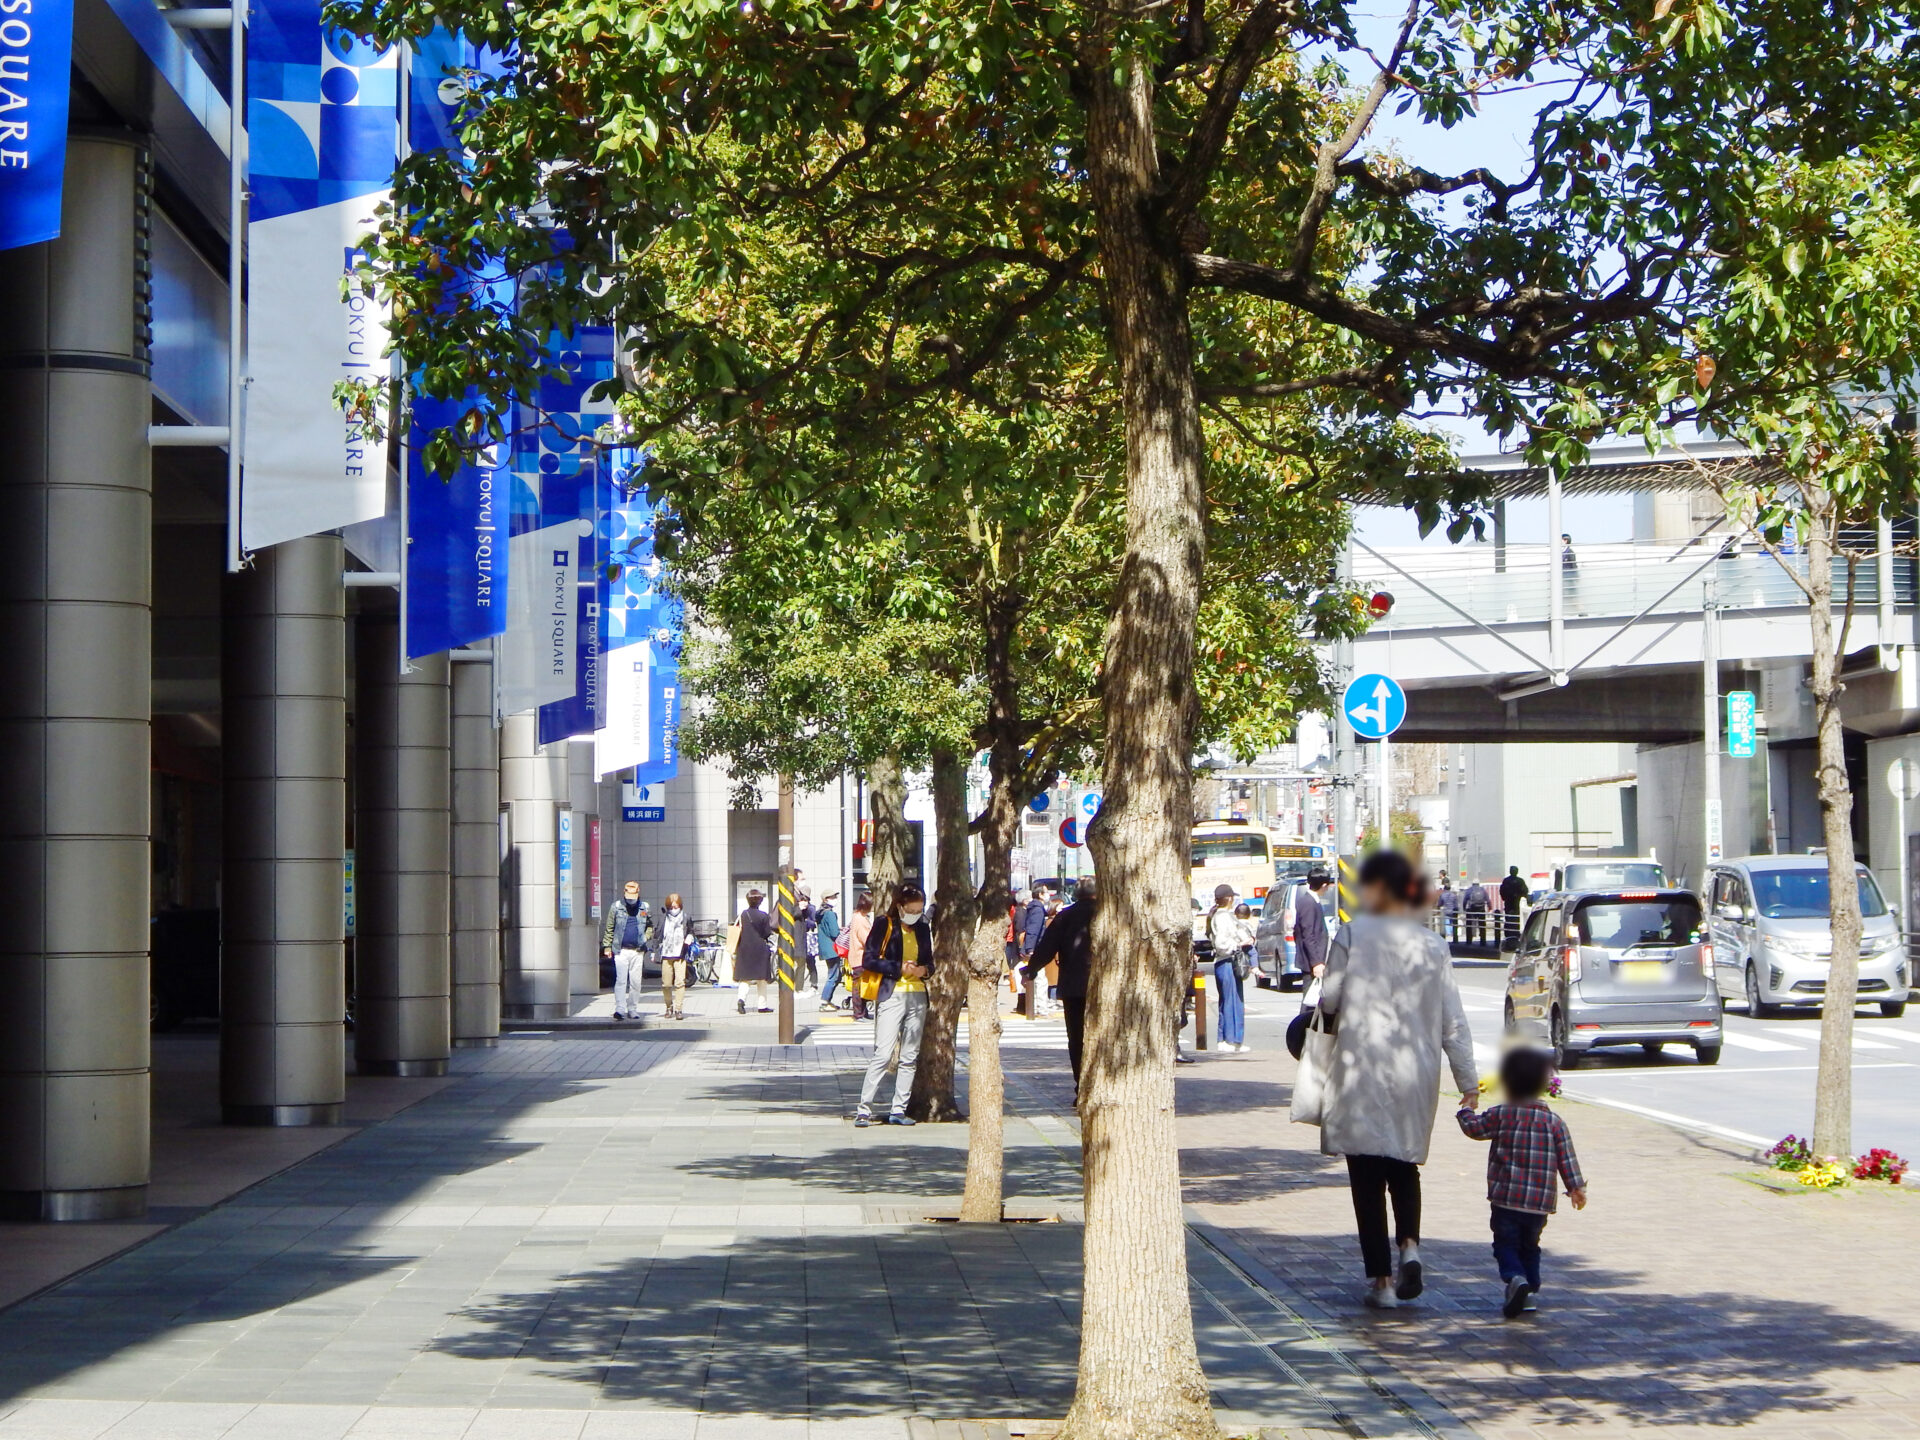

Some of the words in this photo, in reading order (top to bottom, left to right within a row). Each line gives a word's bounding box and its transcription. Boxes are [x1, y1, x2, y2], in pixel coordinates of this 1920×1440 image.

[0, 0, 32, 169] SQUARE
[479, 471, 492, 522] TOKYU
[475, 534, 492, 607] SQUARE
[554, 569, 565, 610] TOKYU
[552, 619, 565, 676] SQUARE
[587, 620, 597, 654] TOKYU
[585, 662, 597, 711] SQUARE
[664, 700, 673, 725] TOKYU
[627, 810, 660, 819] 横浜銀行
